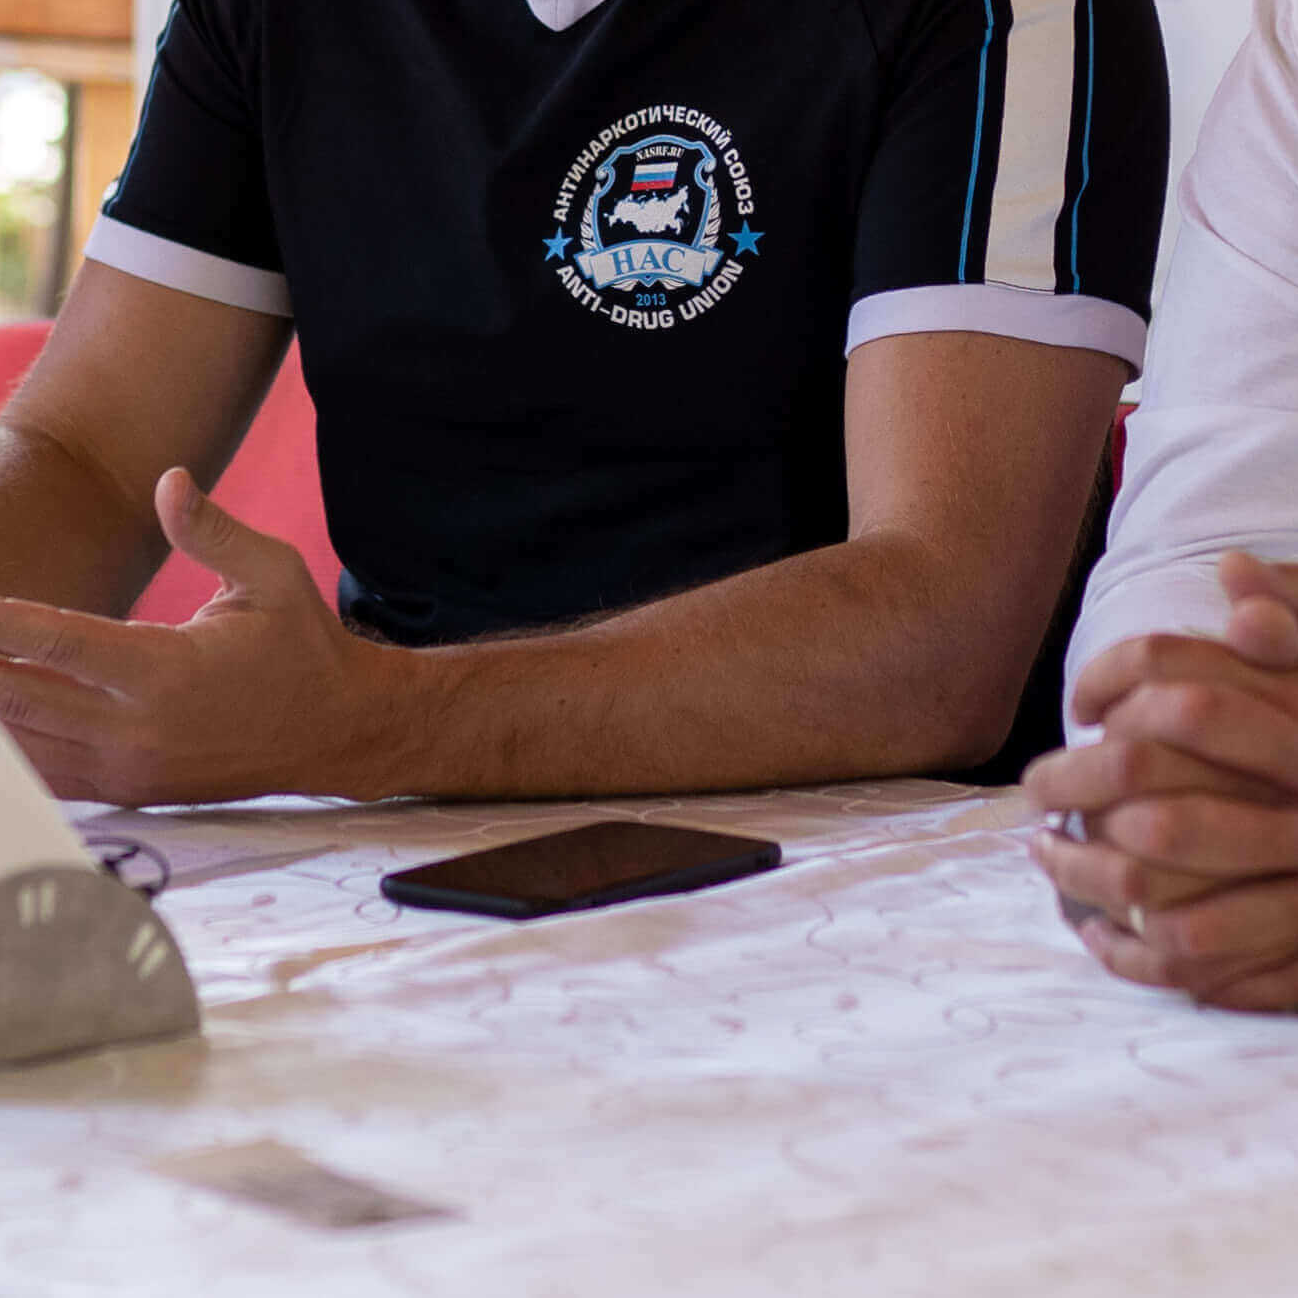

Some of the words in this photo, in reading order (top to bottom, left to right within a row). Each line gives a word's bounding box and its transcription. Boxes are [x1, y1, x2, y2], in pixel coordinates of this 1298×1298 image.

[553, 104, 733, 223] АНТИНАРКОТИЧЕСКИЙ
[722, 148, 754, 215] СОЮЗ
[611, 248, 686, 276] НАС
[555, 264, 675, 330] ANTI-DRUG
[677, 259, 744, 321] UNION
[635, 293, 667, 307] 2013
